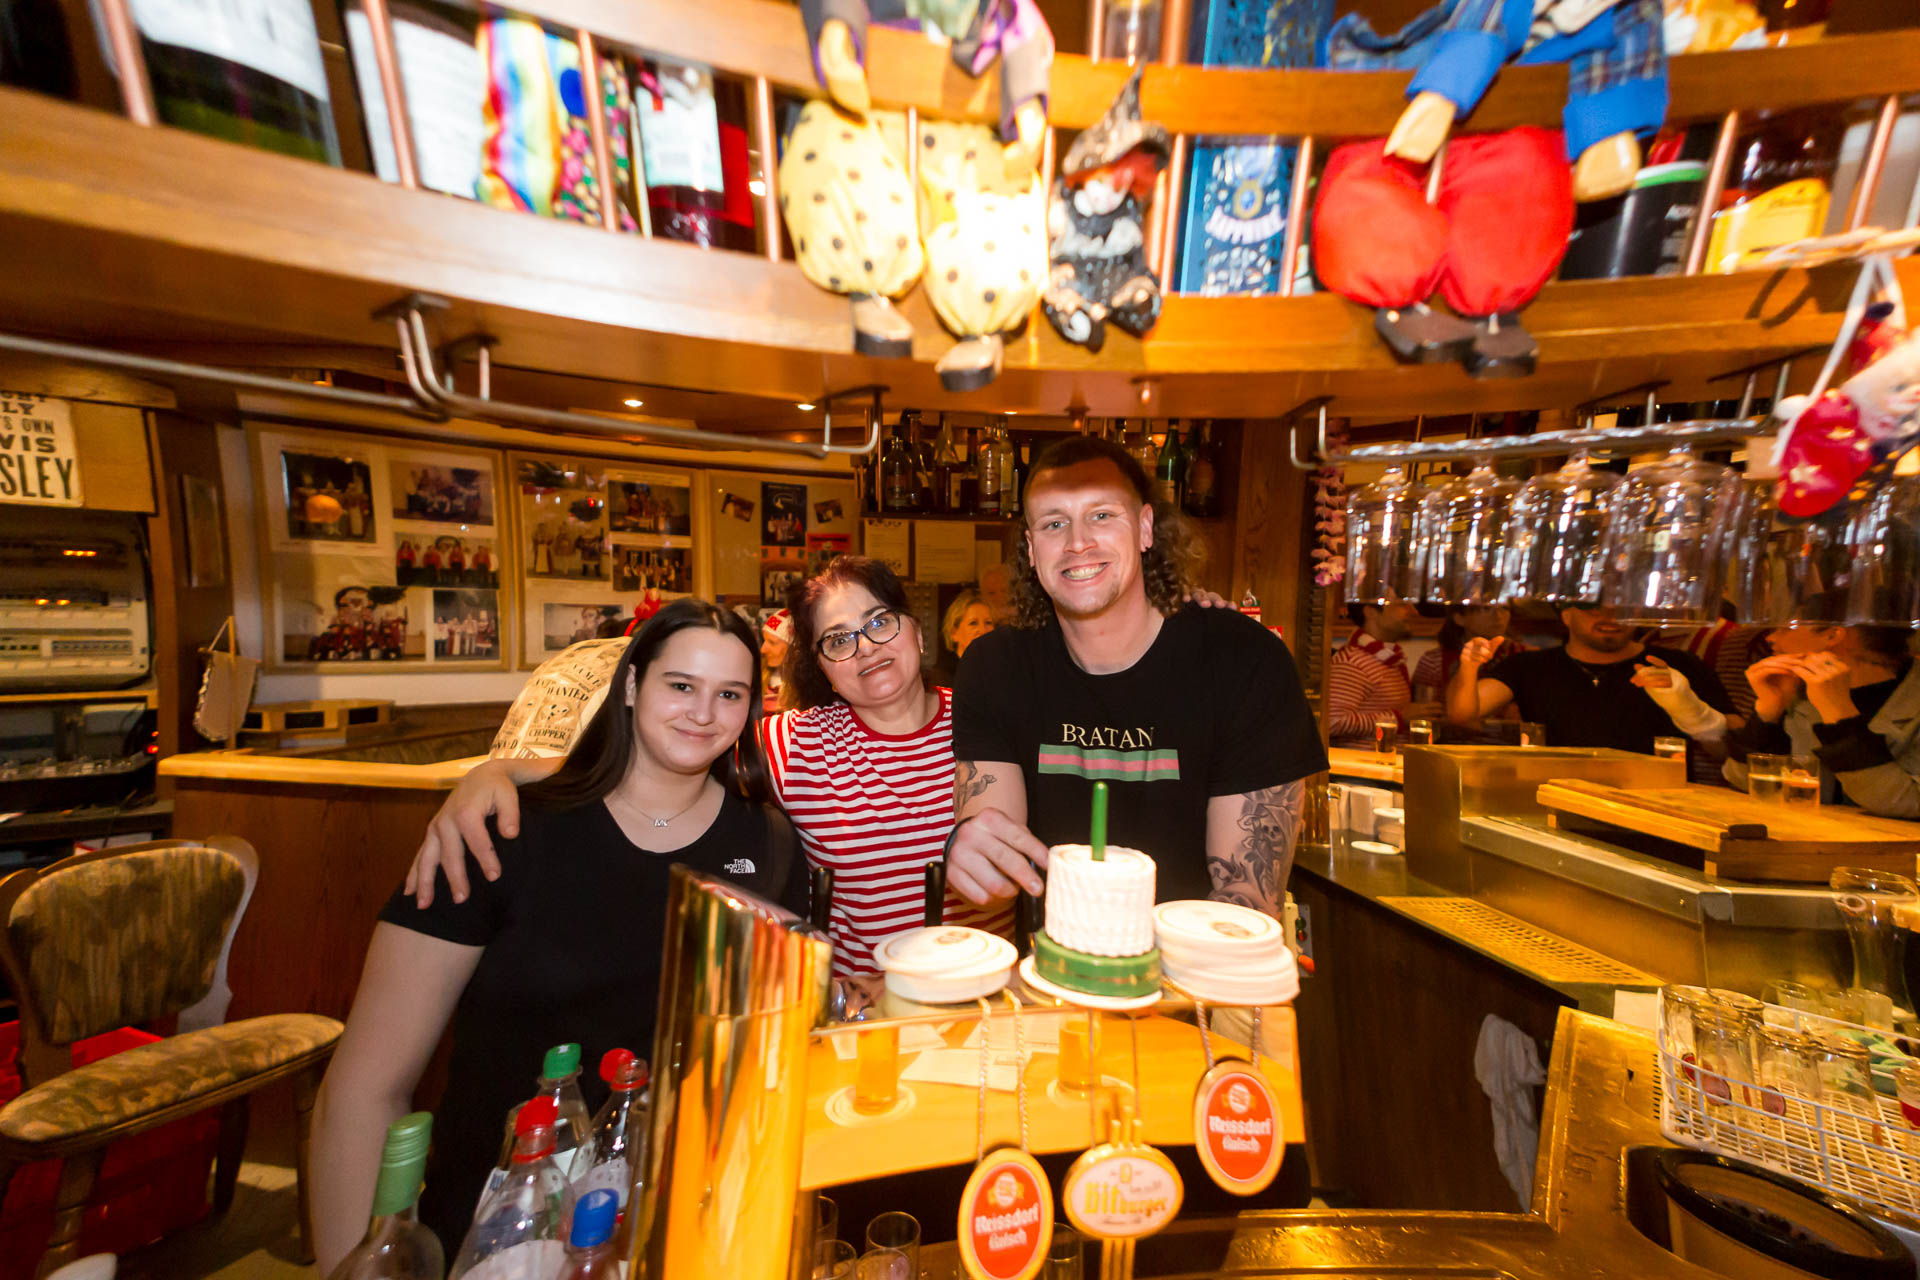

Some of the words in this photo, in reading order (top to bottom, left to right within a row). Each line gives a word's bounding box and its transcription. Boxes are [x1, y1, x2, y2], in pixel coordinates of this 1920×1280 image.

[21, 418, 54, 434] OWN
[546, 685, 589, 702] WANTED
[528, 727, 568, 741] CHOPPER
[1061, 723, 1155, 749] BRATAN
[1207, 1115, 1272, 1137] Reissdorf
[975, 1202, 1039, 1236] Reissdorf
